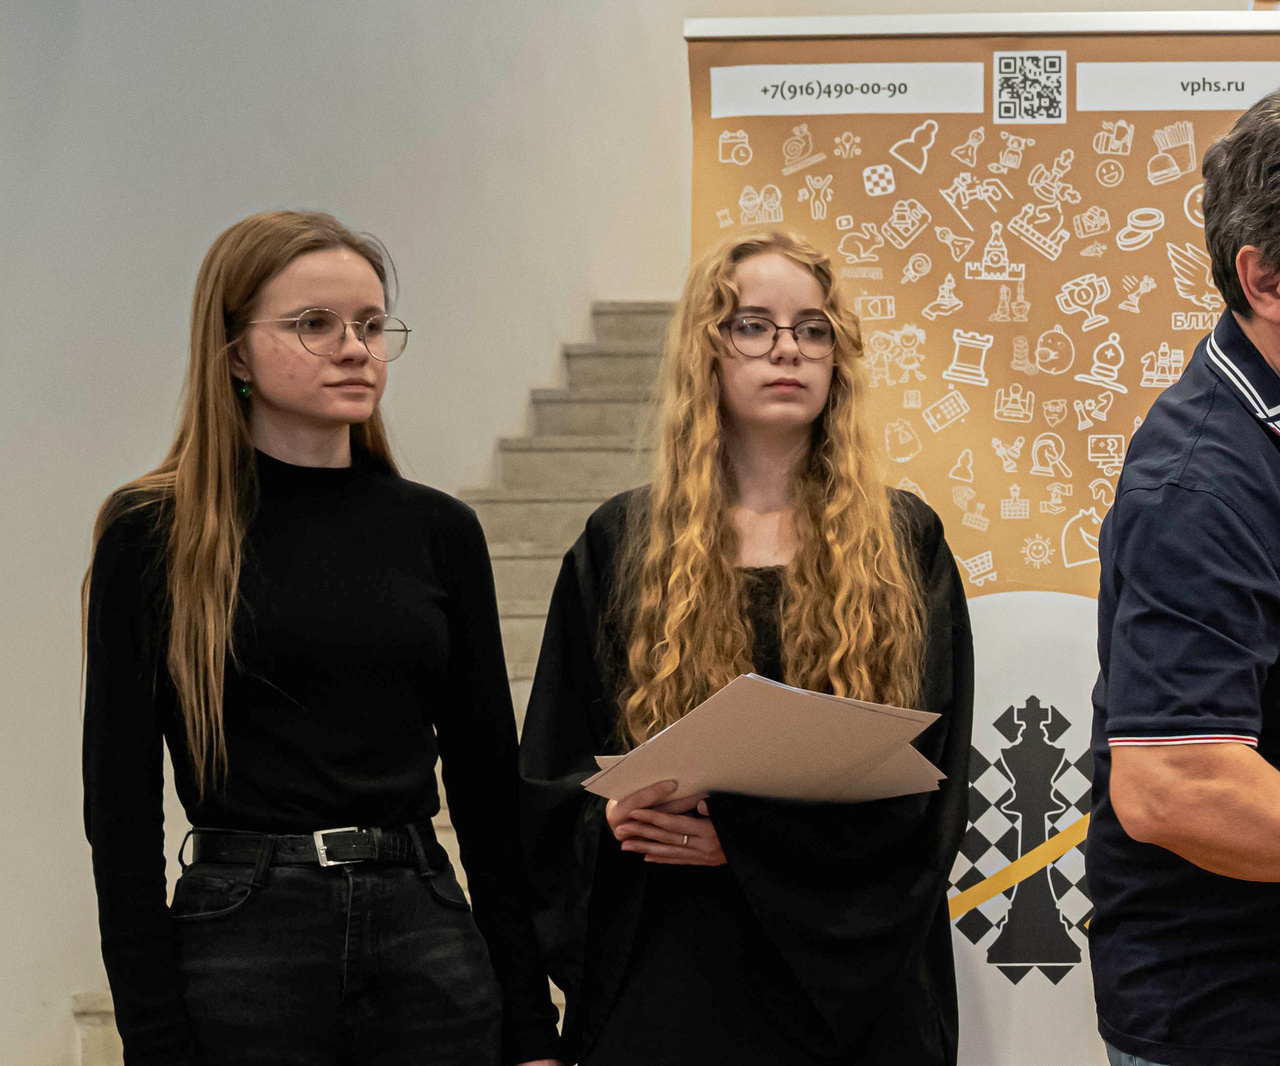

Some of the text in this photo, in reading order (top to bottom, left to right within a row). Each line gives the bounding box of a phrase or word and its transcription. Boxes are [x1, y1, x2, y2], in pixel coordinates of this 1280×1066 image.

[761, 80, 908, 100] +7(916)490-00-90
[1180, 77, 1245, 96] vphs.ru
[1171, 312, 1222, 331] БЛИ
